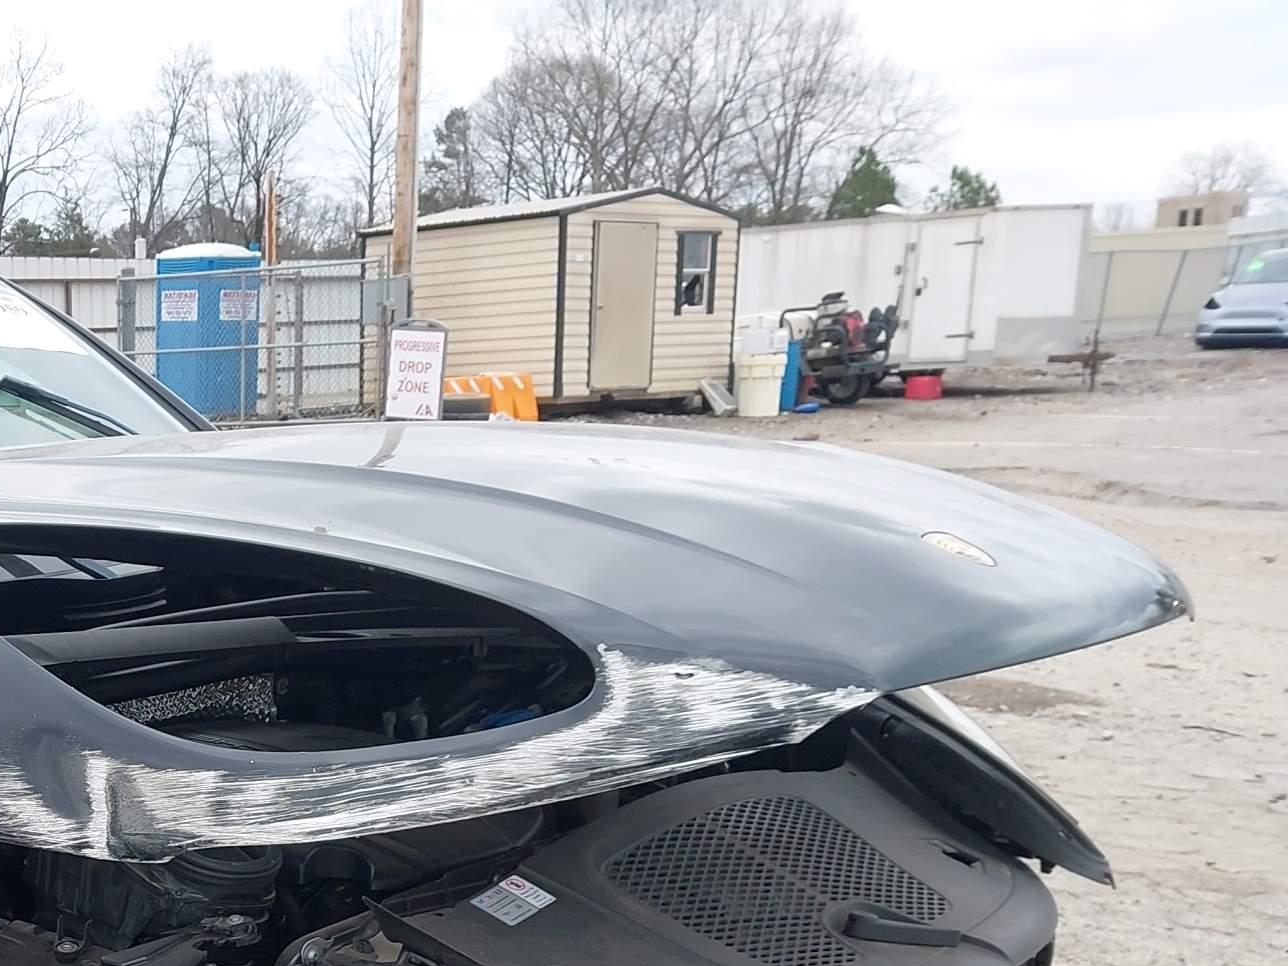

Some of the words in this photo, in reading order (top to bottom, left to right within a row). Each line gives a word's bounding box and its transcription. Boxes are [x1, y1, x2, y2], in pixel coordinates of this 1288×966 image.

[393, 339, 441, 352] PROGRESSIVE
[398, 360, 433, 374] DROP
[397, 379, 431, 394] ZONE
